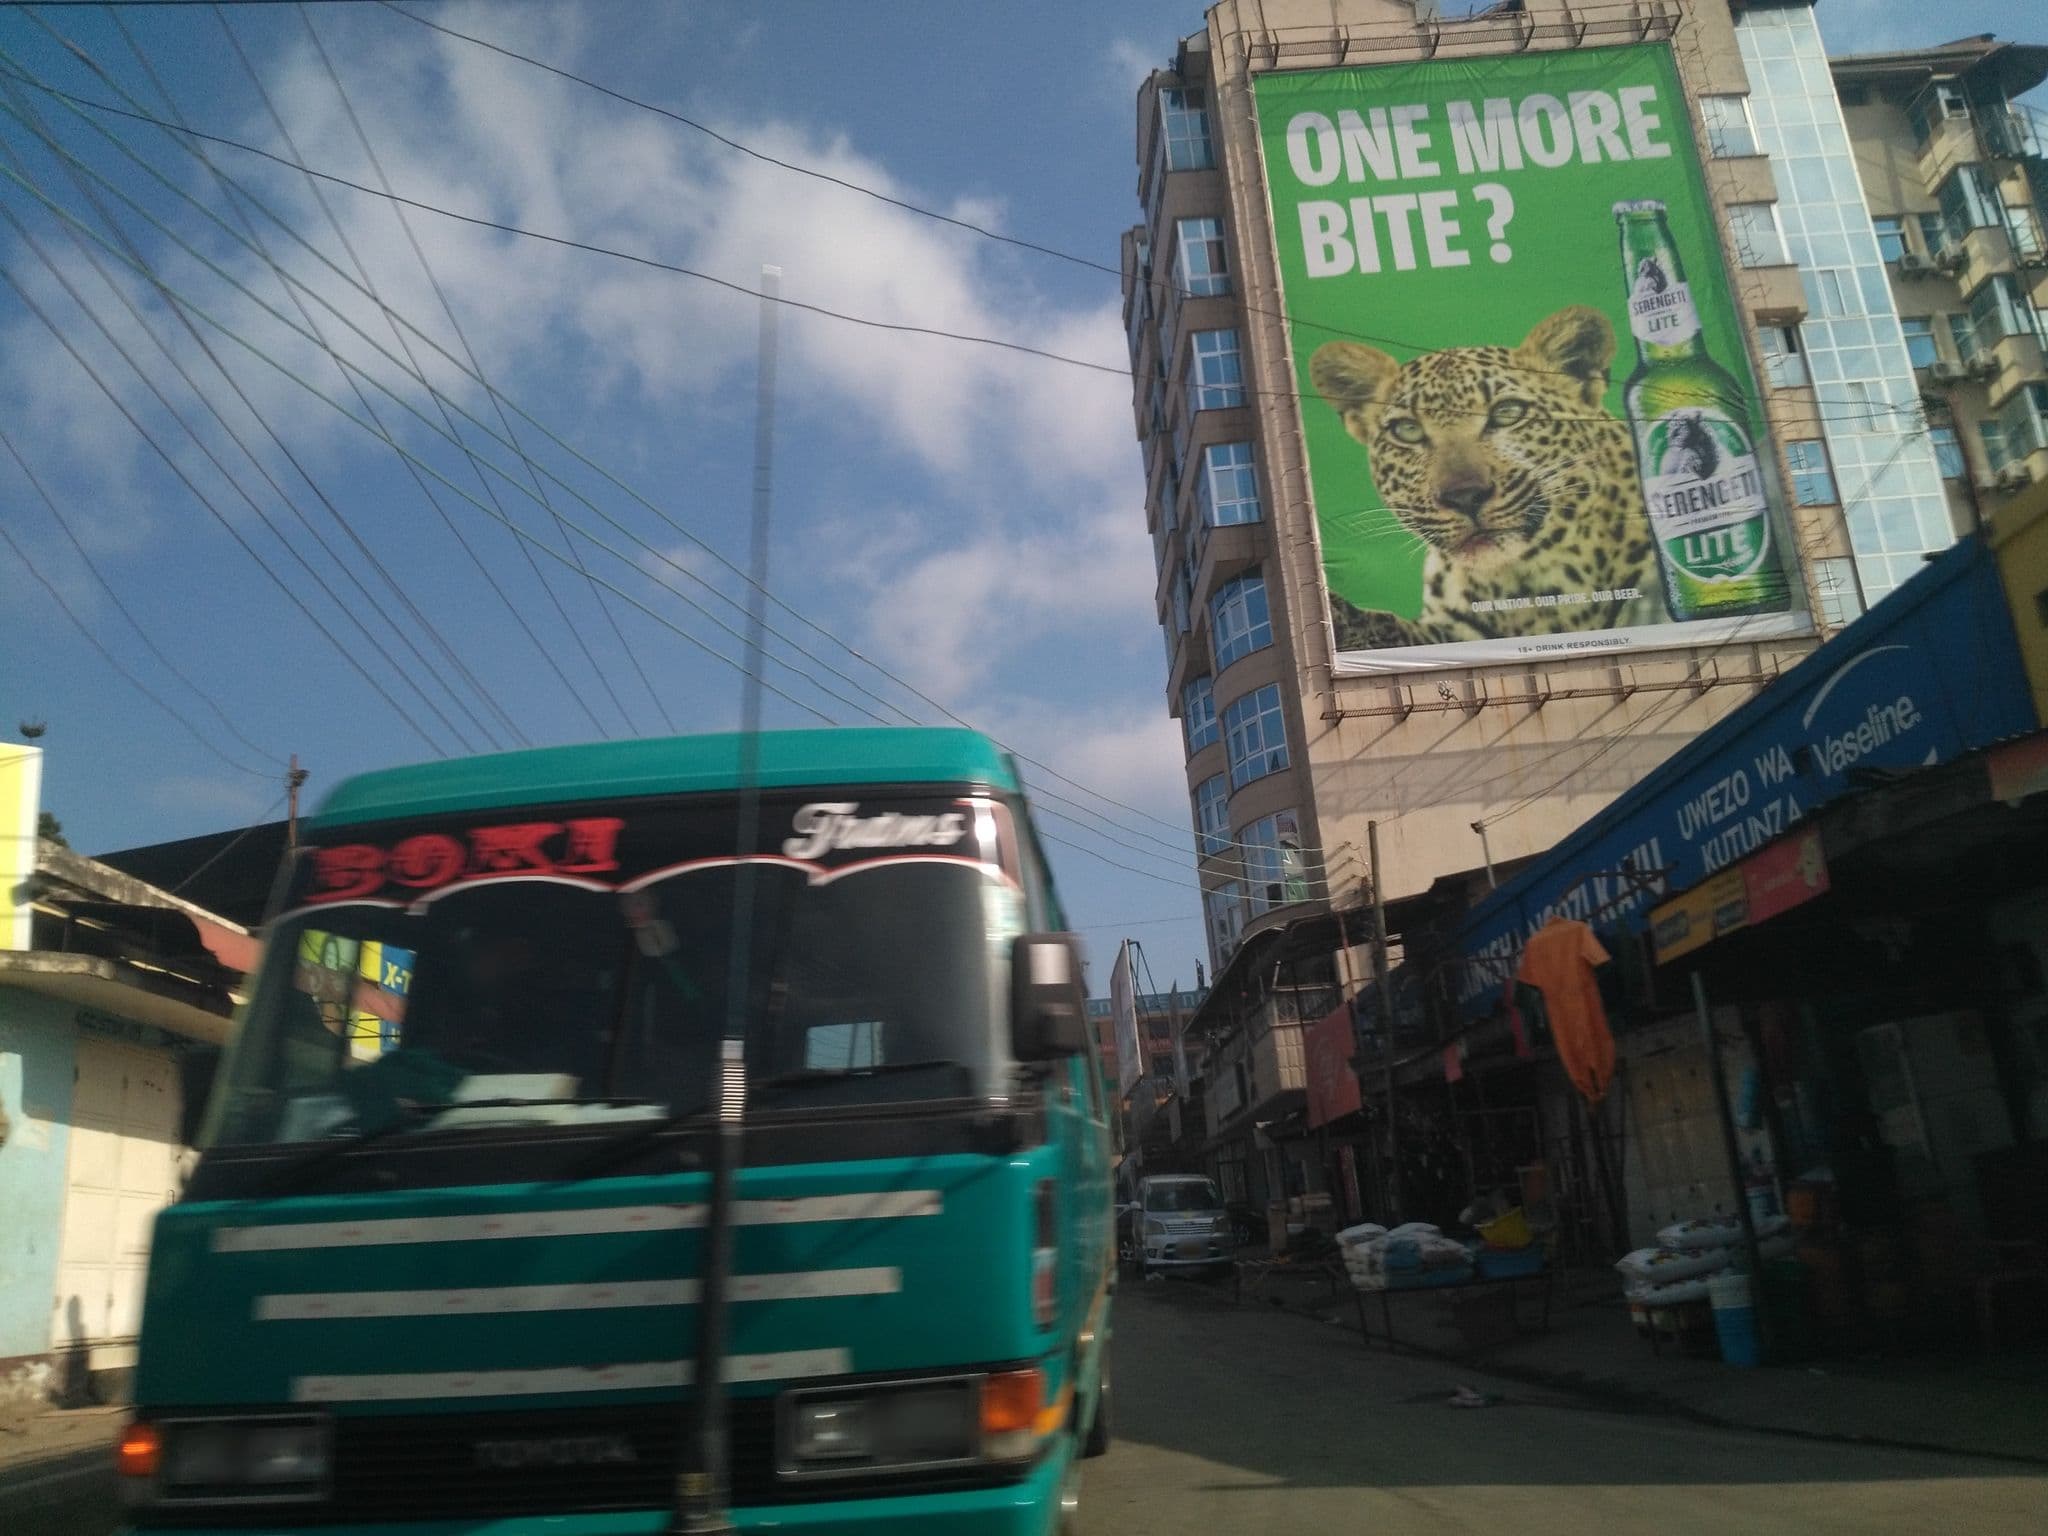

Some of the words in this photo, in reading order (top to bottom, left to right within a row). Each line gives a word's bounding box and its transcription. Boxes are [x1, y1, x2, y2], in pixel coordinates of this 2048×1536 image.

[1286, 104, 1441, 187] ONE
[1446, 85, 1672, 175] MORE
[1633, 290, 1687, 316] SERENGETI
[1647, 313, 1680, 333] LITE
[1683, 523, 1752, 563] LITE
[1471, 600, 1492, 613] OUR
[1494, 597, 1534, 611] NATION.
[1535, 595, 1557, 608] OUR
[1557, 592, 1591, 606] PRIDE.
[1592, 590, 1613, 603] OUR
[1614, 587, 1643, 601] BEER.
[1517, 645, 1534, 654] 18+
[1535, 642, 1565, 653] DRINK
[1677, 769, 1750, 840] UWEZO
[1754, 744, 1796, 789] WA
[1701, 792, 1802, 873] KUTUNZA
